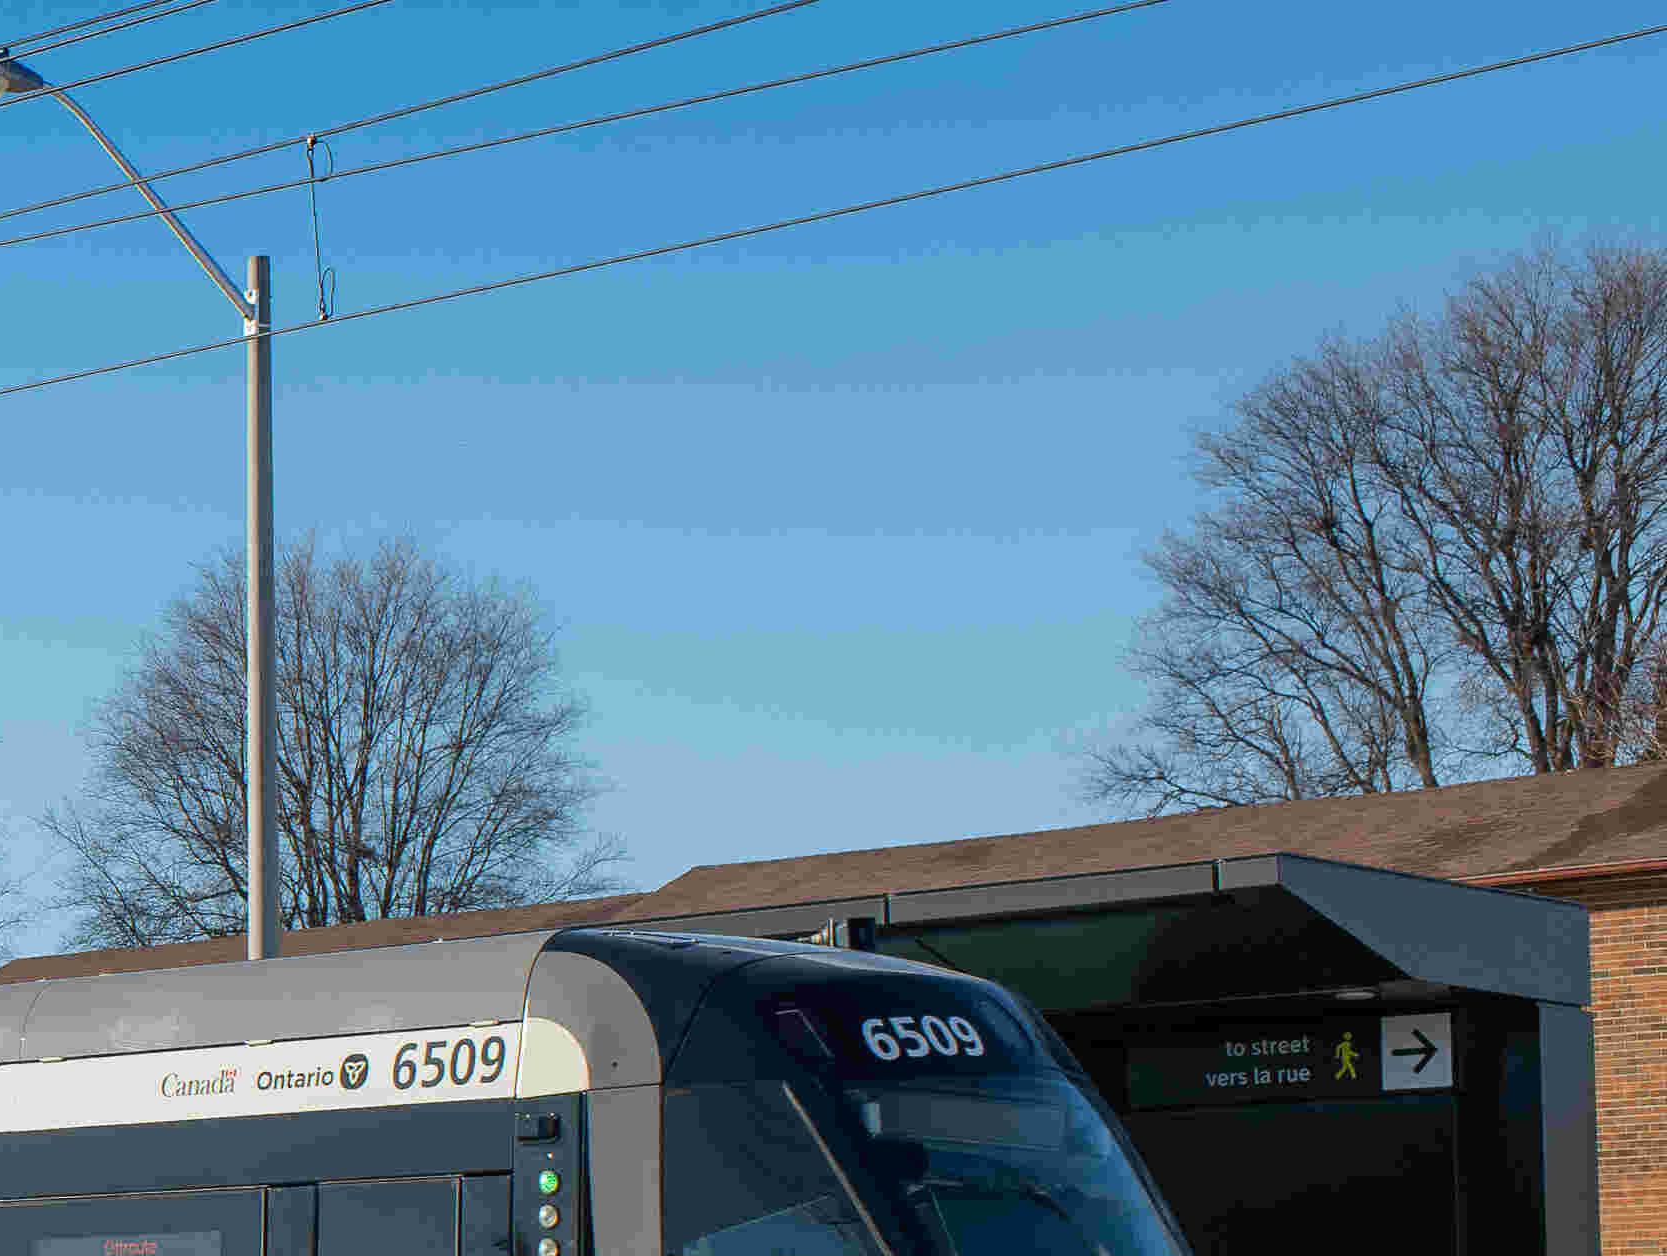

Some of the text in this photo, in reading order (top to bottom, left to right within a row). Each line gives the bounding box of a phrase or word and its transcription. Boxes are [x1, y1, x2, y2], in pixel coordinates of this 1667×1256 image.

[860, 1015, 986, 1060] 6509
[1224, 1035, 1311, 1056] to street
[161, 1035, 507, 1098] Canada Ontario 6509
[1205, 1066, 1311, 1085] vers la rue
